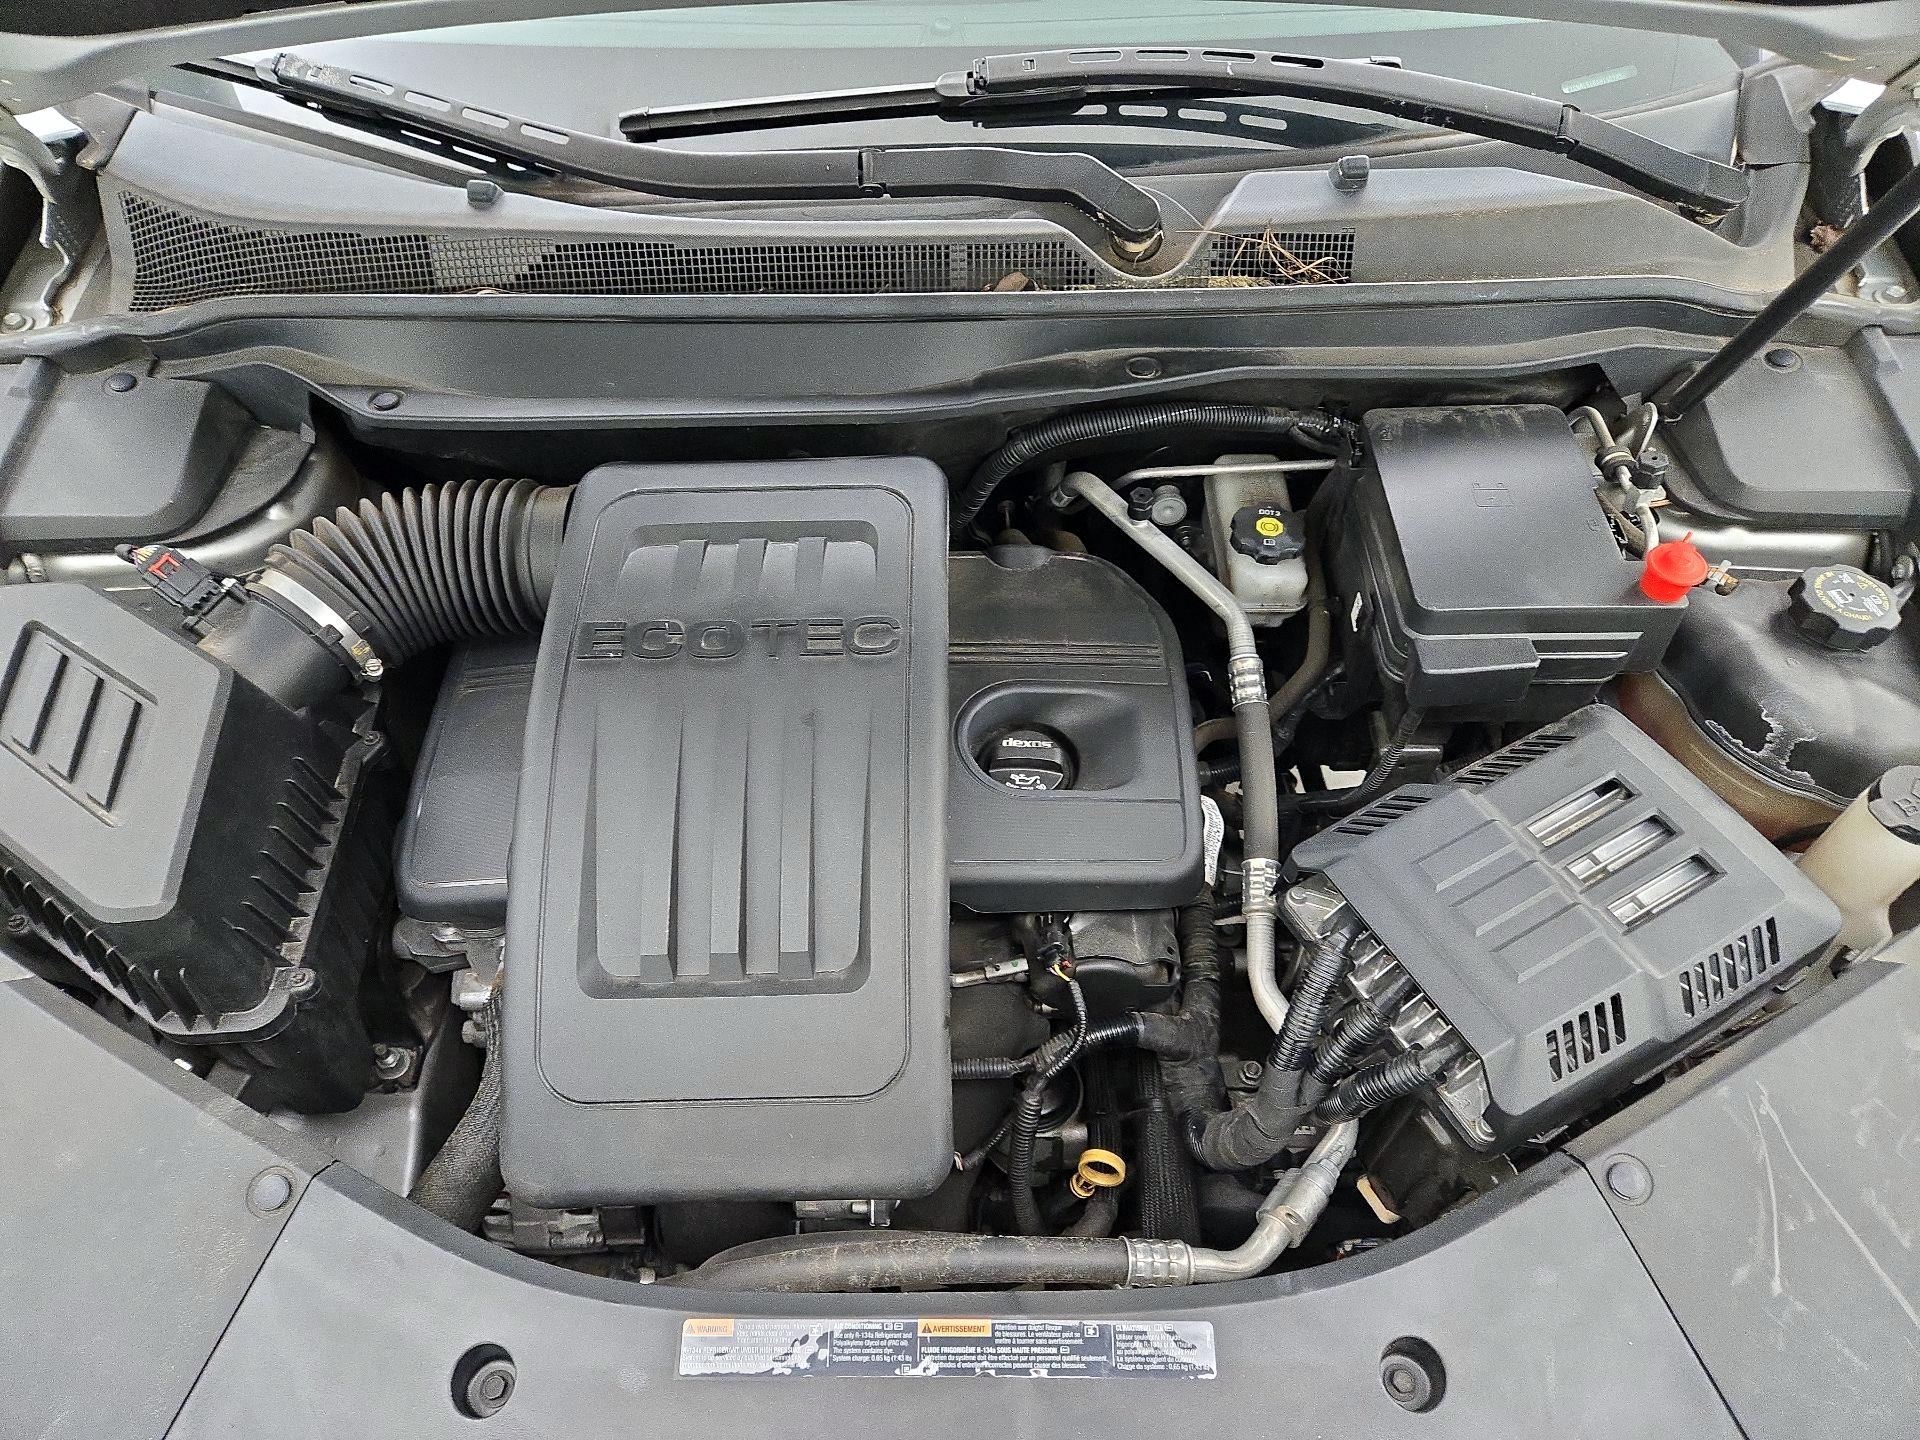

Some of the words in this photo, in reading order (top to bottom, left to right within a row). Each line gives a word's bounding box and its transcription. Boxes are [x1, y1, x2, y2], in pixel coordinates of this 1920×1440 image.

[1258, 508, 1275, 516] DOT
[577, 616, 901, 659] ECOTEC
[1002, 737, 1054, 748] dexos
[697, 1324, 728, 1335] WARNING
[932, 1325, 986, 1333] AVERTISSEMENT
[832, 1354, 851, 1362] System
[955, 1354, 976, 1362] système
[1036, 1354, 1062, 1362] personnel
[1061, 1354, 1080, 1362] qualifié
